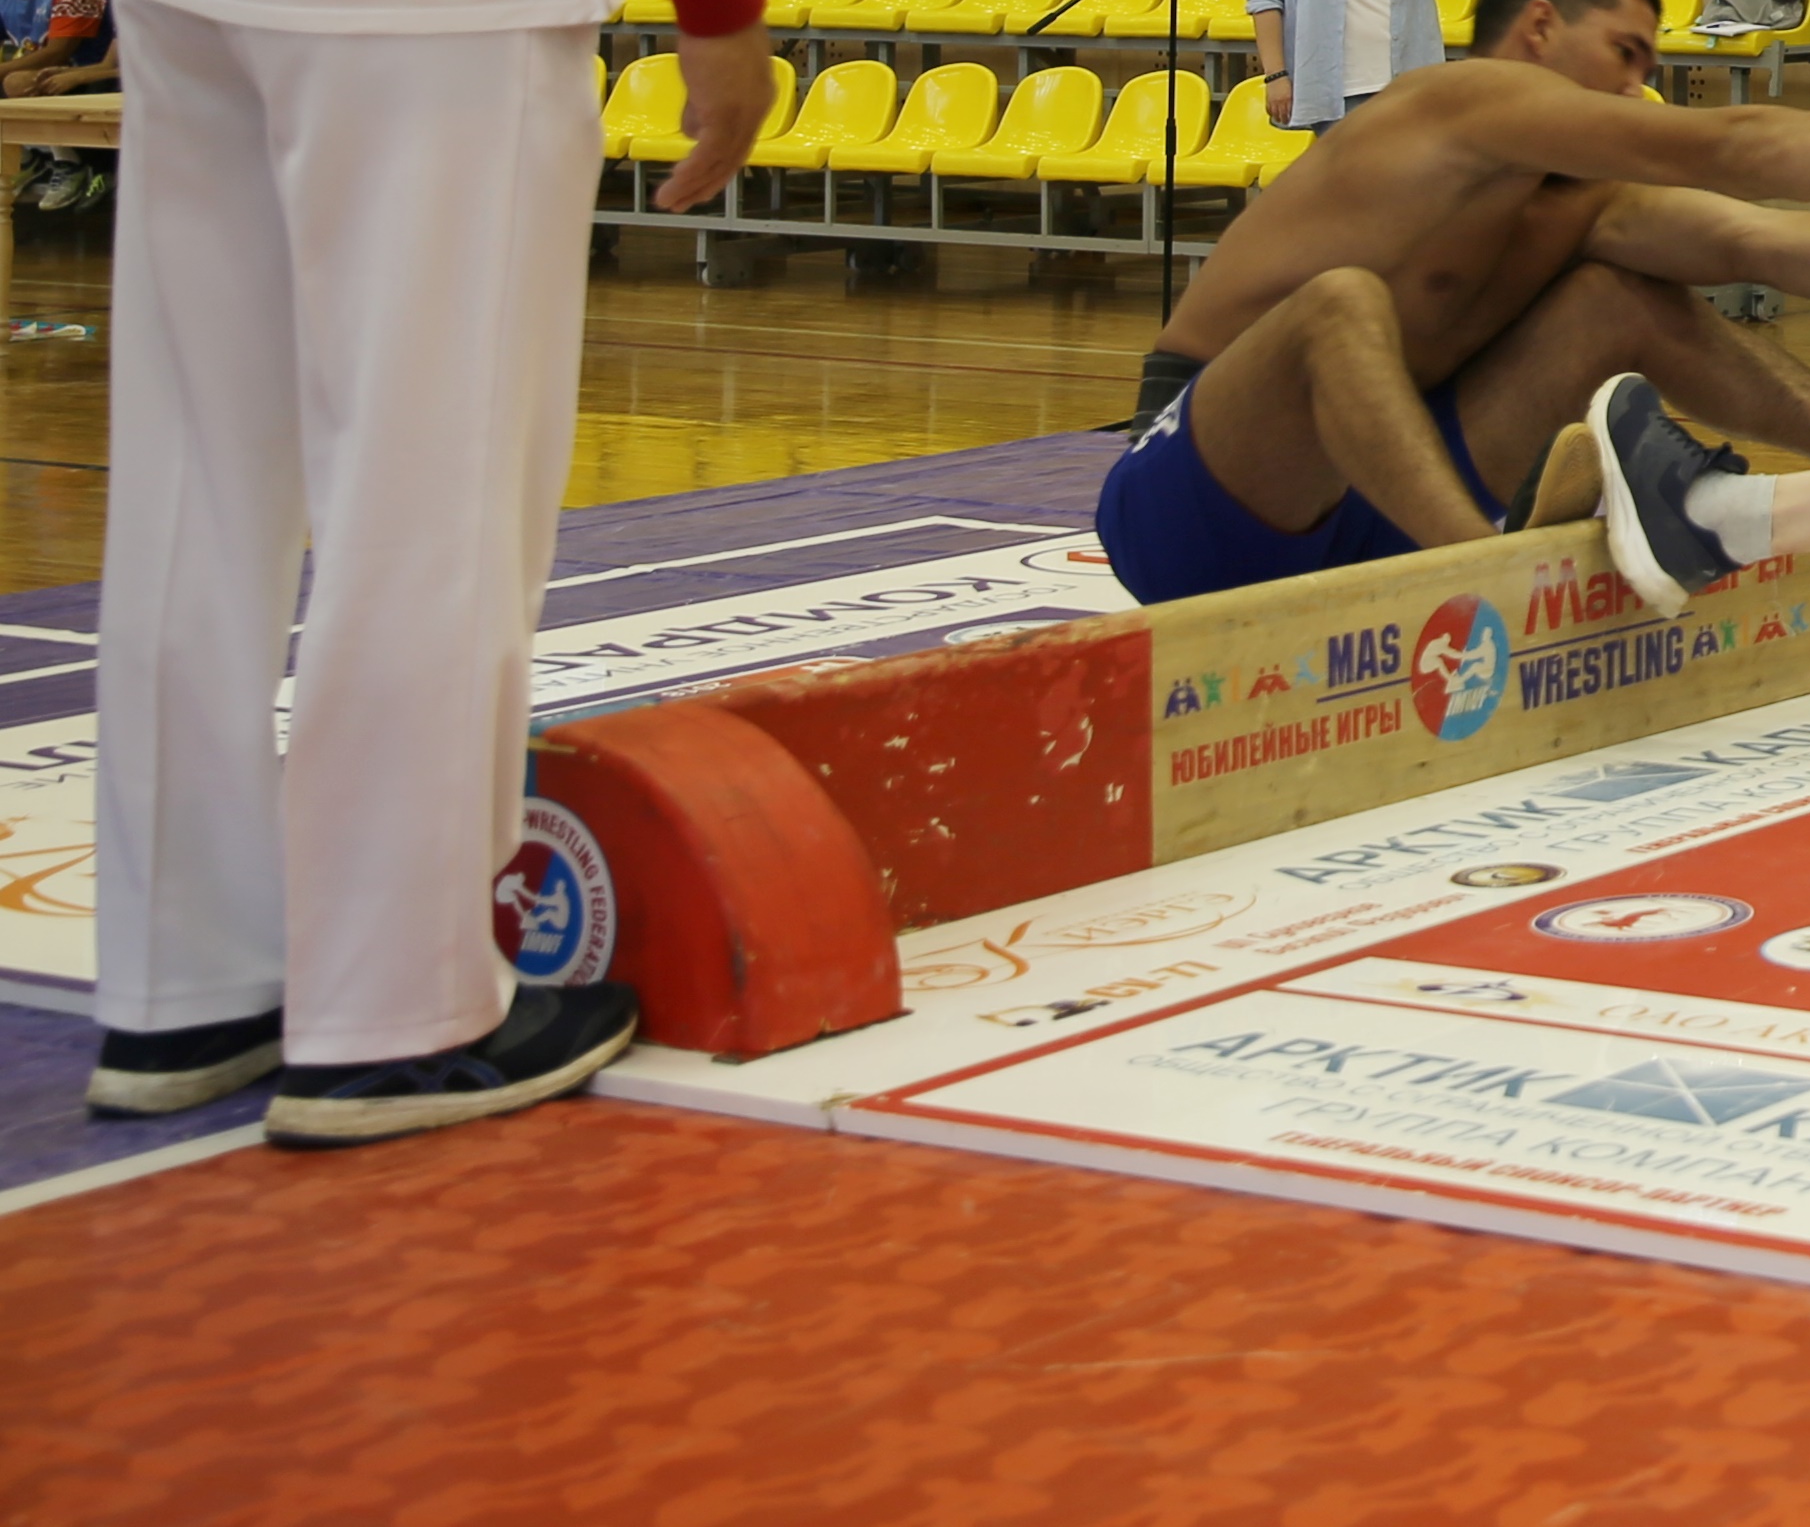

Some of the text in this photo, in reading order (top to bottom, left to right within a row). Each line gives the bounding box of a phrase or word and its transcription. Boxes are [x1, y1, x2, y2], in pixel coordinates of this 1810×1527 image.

[1327, 622, 1403, 690] MAS
[1519, 625, 1685, 711] WRESTLING
[1171, 698, 1403, 787] ЮБИЛЕЙНЫЕ ИГРЫ
[1275, 799, 1591, 884] АРКТИК
[1337, 841, 1519, 890] ОБЩЕСТВО
[1546, 766, 1774, 829] ОГРАНИЧЕННОЙ
[1546, 801, 1742, 851] ГРУППА
[1628, 813, 1765, 853] ГЕНЕРАЛЬНЫЙ
[1597, 1004, 1732, 1034] ОАО
[1126, 1054, 1383, 1095] ОБЩЕСТВО
[1385, 1091, 1420, 1102] С
[1413, 1094, 1721, 1145] ОГРАНИЧЕННОЙ
[1173, 1032, 1576, 1100] АРКТИК
[1263, 1097, 1517, 1146] ГРУППА
[1273, 1132, 1783, 1215] ГЕНЕРАЛЬНЫЙ СПОНСОР-ПАРТНЕР
